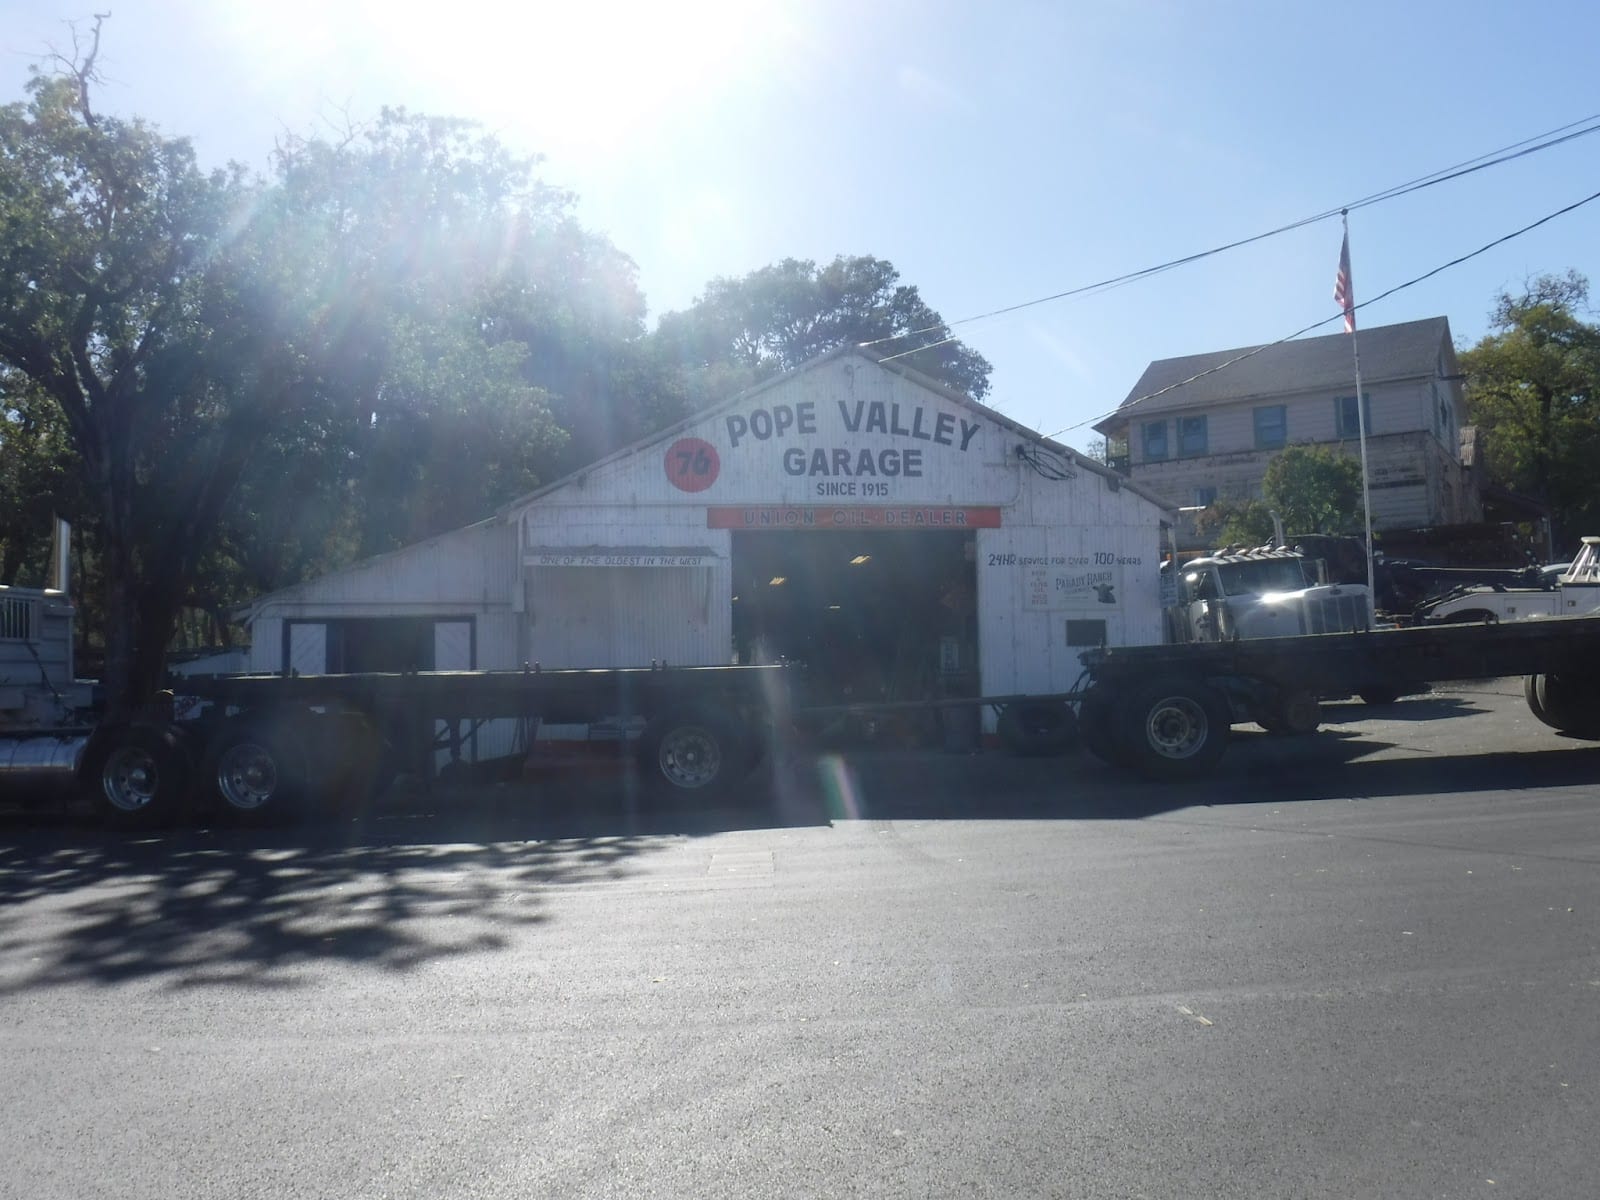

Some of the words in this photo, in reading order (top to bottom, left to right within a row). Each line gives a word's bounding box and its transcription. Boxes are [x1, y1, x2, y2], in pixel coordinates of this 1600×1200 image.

[726, 401, 818, 448] POPE
[838, 399, 981, 452] VALLEY
[676, 451, 712, 476] 76
[783, 447, 922, 477] GARAGE
[816, 483, 857, 496] SINCE
[862, 482, 889, 496] 1915
[744, 510, 816, 525] UNION
[832, 510, 870, 525] OIL
[886, 510, 968, 525] DEALER
[540, 556, 560, 565] ONE
[563, 556, 576, 565] OF
[580, 556, 601, 565] THE
[605, 556, 640, 565] OLDEST
[643, 556, 656, 565] IN
[659, 556, 676, 565] THE
[679, 556, 702, 565] WEST
[988, 553, 1017, 566] 24HR
[1018, 557, 1048, 566] SERVICE
[1051, 557, 1065, 565] FOR
[1068, 557, 1089, 565] OVER
[1094, 552, 1115, 565] 100
[1116, 557, 1142, 566] YEARS
